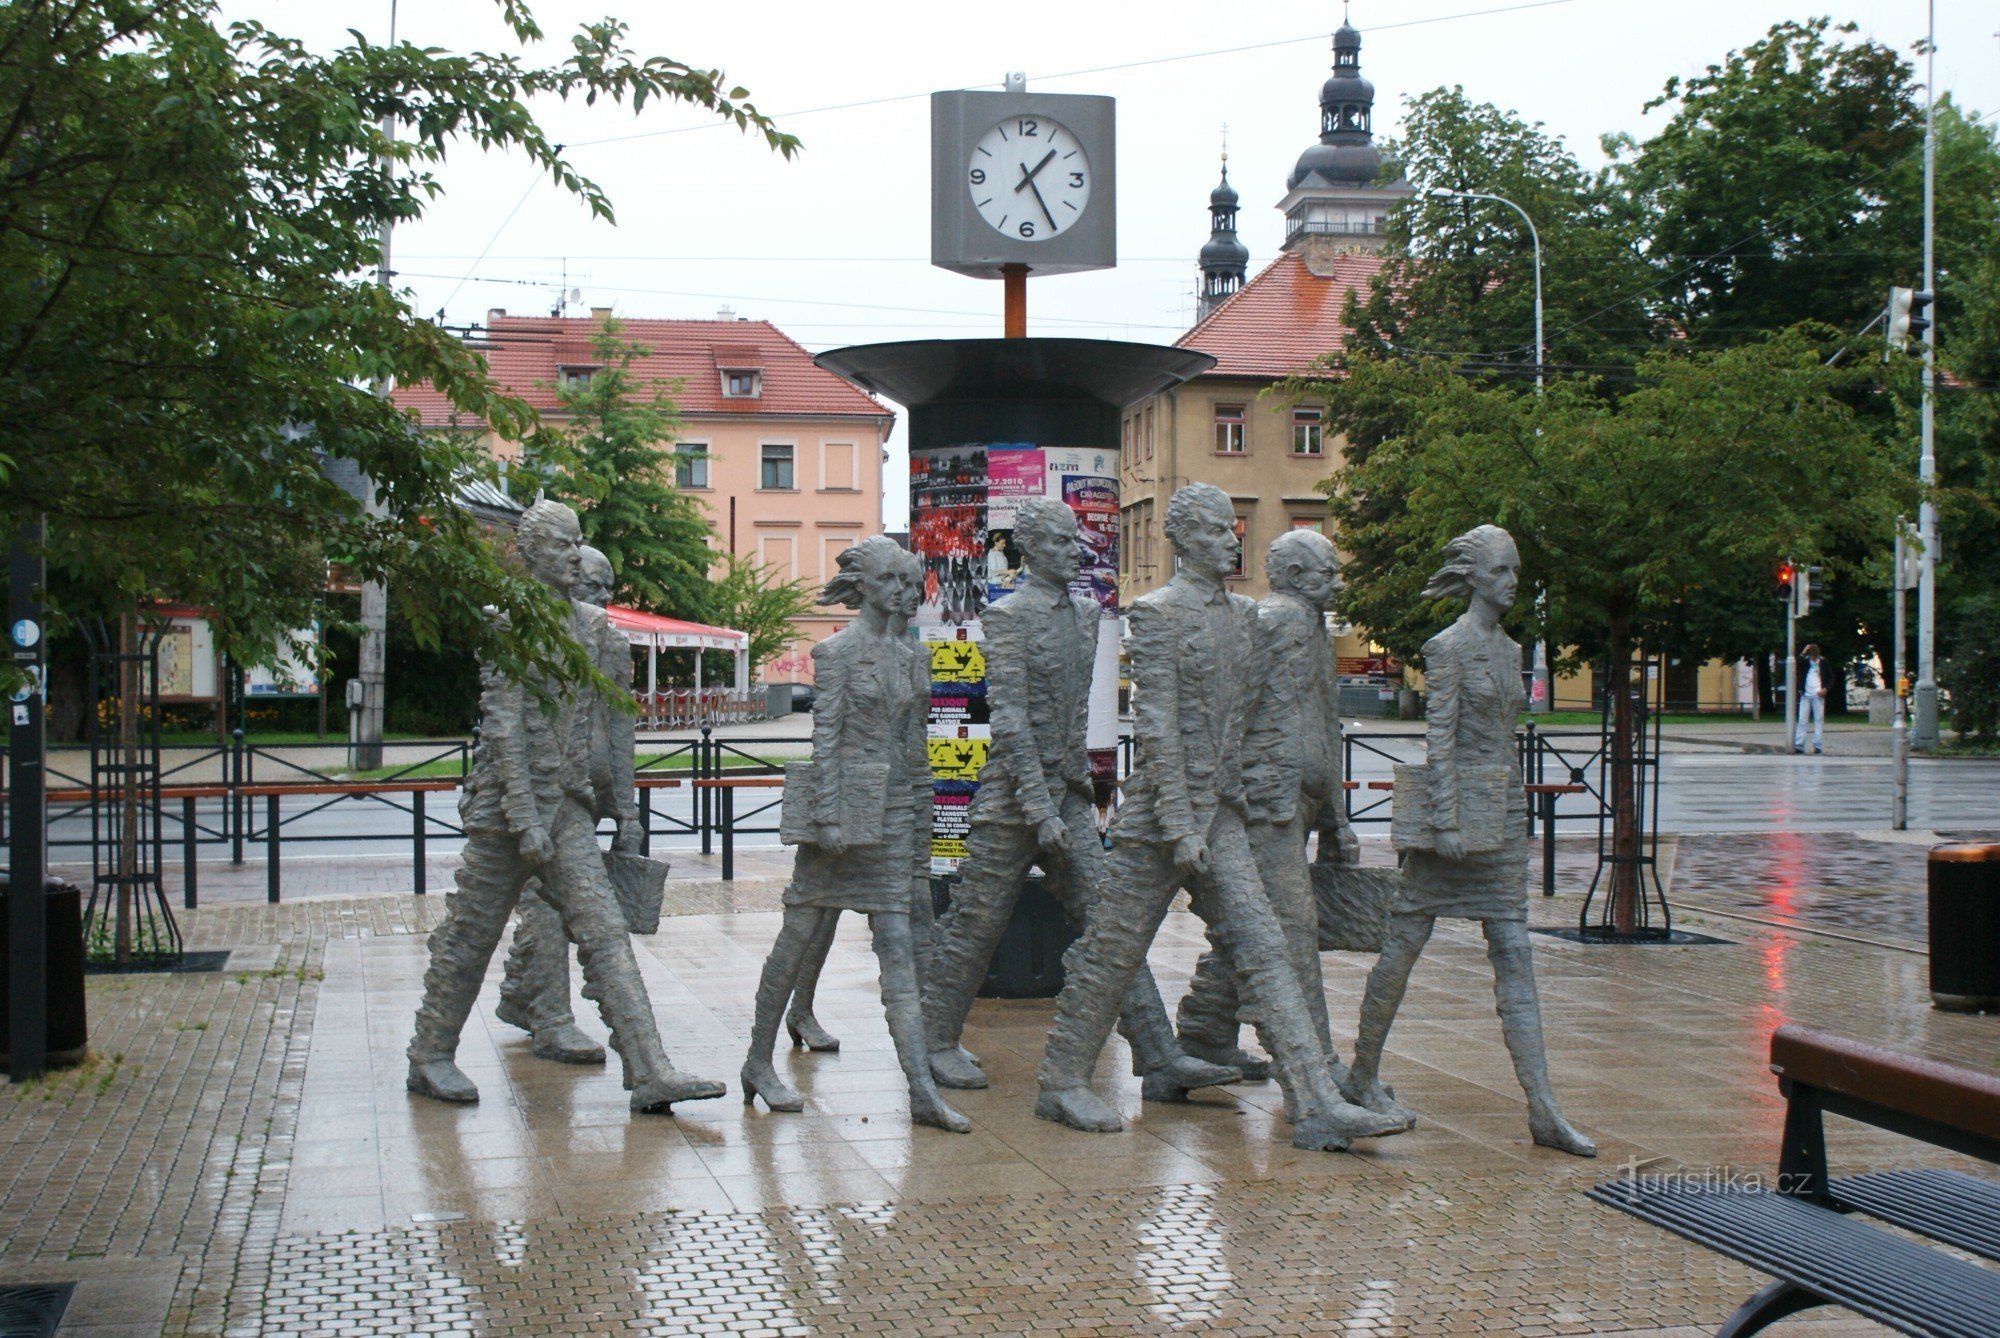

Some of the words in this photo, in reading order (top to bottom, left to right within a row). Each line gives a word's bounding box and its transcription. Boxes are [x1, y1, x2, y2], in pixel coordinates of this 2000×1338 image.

[1018, 120, 1037, 137] 12
[970, 169, 986, 185] 9
[1069, 172, 1084, 188] 3
[1019, 221, 1034, 237] 6
